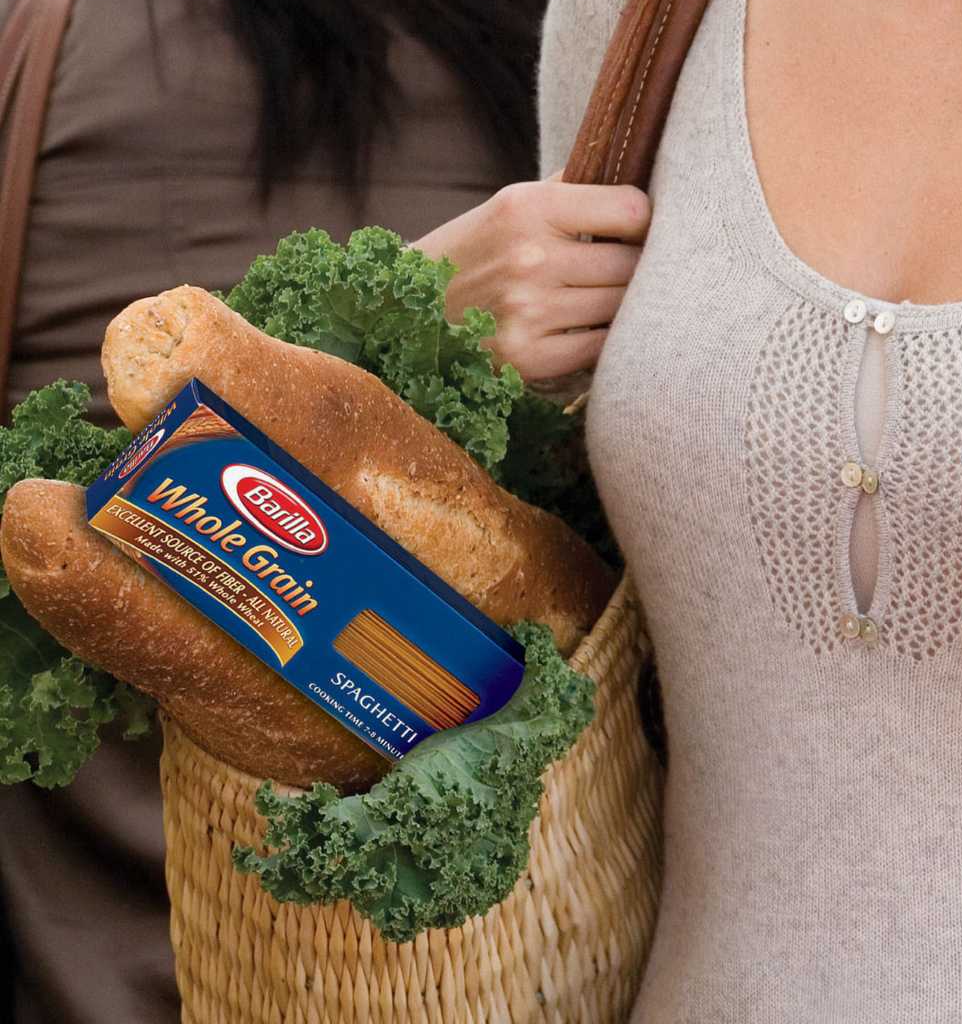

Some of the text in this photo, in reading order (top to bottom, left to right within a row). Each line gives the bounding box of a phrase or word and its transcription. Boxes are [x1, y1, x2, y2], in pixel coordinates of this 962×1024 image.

[147, 477, 319, 616] Whole Grain
[243, 485, 316, 545] Barilla
[106, 504, 163, 539] EXCELLENT
[160, 534, 206, 565] SOURCE
[201, 560, 222, 580] OF
[216, 571, 247, 597] FIBER
[246, 596, 268, 616] ALL
[261, 608, 299, 648] NATURAL
[135, 535, 265, 628] Made with 51% Whole Wheat
[308, 682, 346, 713] COOKING
[344, 711, 365, 728] TIME
[330, 672, 418, 744] SPAGHETTI
